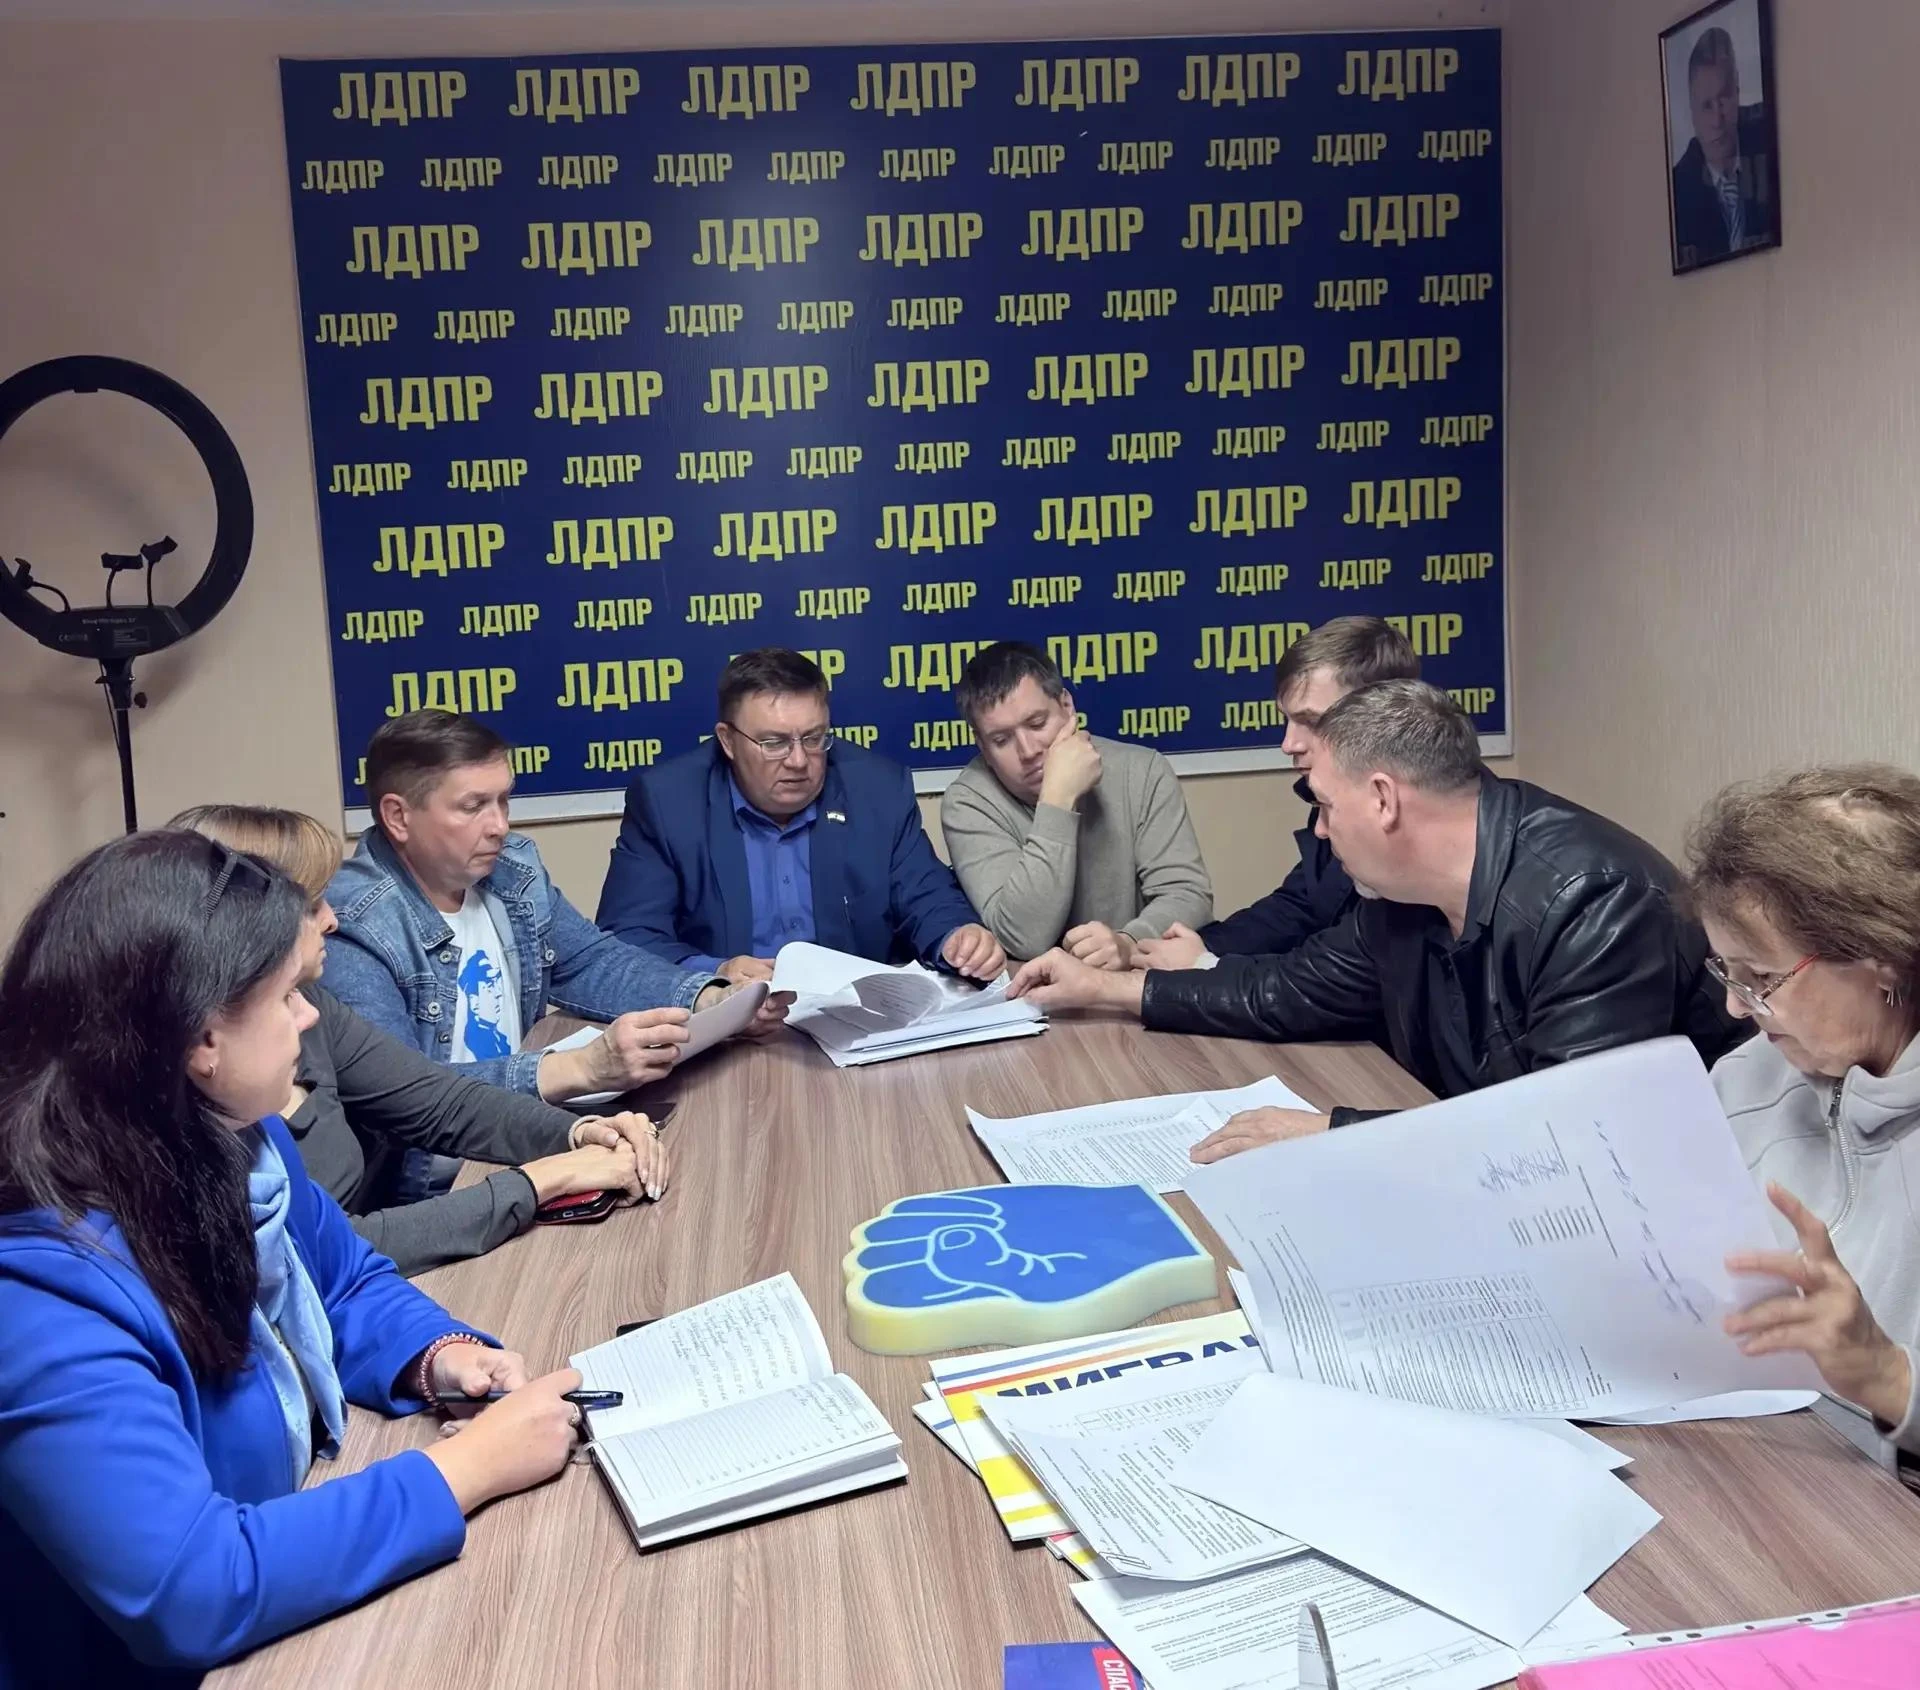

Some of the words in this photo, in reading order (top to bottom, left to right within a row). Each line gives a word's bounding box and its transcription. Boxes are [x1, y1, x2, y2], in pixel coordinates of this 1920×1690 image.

[332, 71, 466, 126] ЛДПР
[508, 68, 639, 123] ЛДПР
[682, 65, 809, 119] ЛДПР
[851, 62, 976, 116] ЛДПР
[1015, 58, 1139, 111] ЛДПР
[1177, 53, 1299, 107] ЛДПР
[1338, 49, 1457, 100] ЛДПР
[303, 160, 383, 193] ЛДПР
[421, 158, 502, 190] ЛДПР
[541, 155, 617, 188] ЛДПР
[655, 154, 732, 185] ЛДПР
[767, 151, 845, 183] ЛДПР
[879, 148, 955, 180] ЛДПР
[991, 145, 1064, 176] ЛДПР
[1099, 142, 1172, 173] ЛДПР
[1206, 138, 1280, 169] ЛДПР
[1313, 134, 1386, 164] ЛДПР
[1420, 130, 1490, 159] ЛДПР
[345, 225, 479, 279] ЛДПР
[521, 221, 651, 276] ЛДПР
[691, 217, 819, 272] ЛДПР
[858, 213, 983, 267] ЛДПР
[1020, 207, 1143, 261] ЛДПР
[1181, 201, 1302, 253] ЛДПР
[1341, 194, 1458, 247] ЛДПР
[316, 313, 397, 347] ЛДПР
[434, 311, 515, 342] ЛДПР
[551, 307, 630, 340] ЛДПР
[665, 304, 743, 336] ЛДПР
[778, 301, 853, 332] ЛДПР
[888, 297, 963, 330] ЛДПР
[995, 293, 1070, 325] ЛДПР
[1104, 289, 1176, 320] ЛДПР
[1209, 284, 1282, 315] ЛДПР
[1315, 279, 1387, 309] ЛДПР
[1420, 274, 1491, 303] ЛДПР
[360, 375, 492, 430] ЛДПР
[534, 371, 663, 426] ЛДПР
[704, 365, 828, 419] ЛДПР
[867, 359, 989, 413] ЛДПР
[1028, 352, 1148, 406] ЛДПР
[1185, 345, 1305, 397] ЛДПР
[1343, 337, 1461, 390] ЛДПР
[330, 463, 412, 495] ЛДПР
[449, 458, 527, 491] ЛДПР
[564, 455, 641, 487] ЛДПР
[678, 450, 752, 482] ЛДПР
[788, 447, 863, 479] ЛДПР
[896, 442, 969, 473] ЛДПР
[1004, 436, 1076, 468] ЛДПР
[1109, 431, 1182, 463] ЛДПР
[1214, 426, 1286, 457] ЛДПР
[1318, 420, 1389, 452] ЛДПР
[1421, 415, 1493, 445] ЛДПР
[372, 523, 505, 577] ЛДПР
[546, 516, 673, 570] ЛДПР
[714, 509, 837, 562] ЛДПР
[876, 502, 997, 554] ЛДПР
[1034, 493, 1152, 546] ЛДПР
[1189, 485, 1308, 537] ЛДПР
[1343, 477, 1461, 528] ЛДПР
[343, 610, 423, 643] ЛДПР
[461, 604, 540, 636] ЛДПР
[576, 598, 652, 629] ЛДПР
[688, 592, 762, 624] ЛДПР
[797, 587, 869, 618] ЛДПР
[904, 581, 976, 612] ЛДПР
[1009, 576, 1081, 607] ЛДПР
[1115, 570, 1184, 602] ЛДПР
[1219, 564, 1288, 595] ЛДПР
[1321, 559, 1392, 589] ЛДПР
[1423, 552, 1493, 583] ЛДПР
[384, 667, 517, 719] ЛДПР
[556, 658, 683, 713] ЛДПР
[883, 640, 1000, 693] ЛДП
[1384, 613, 1464, 656] ПР
[506, 745, 551, 777] ПР
[584, 739, 661, 772] ЛДПР
[1119, 706, 1191, 737] ЛДПР
